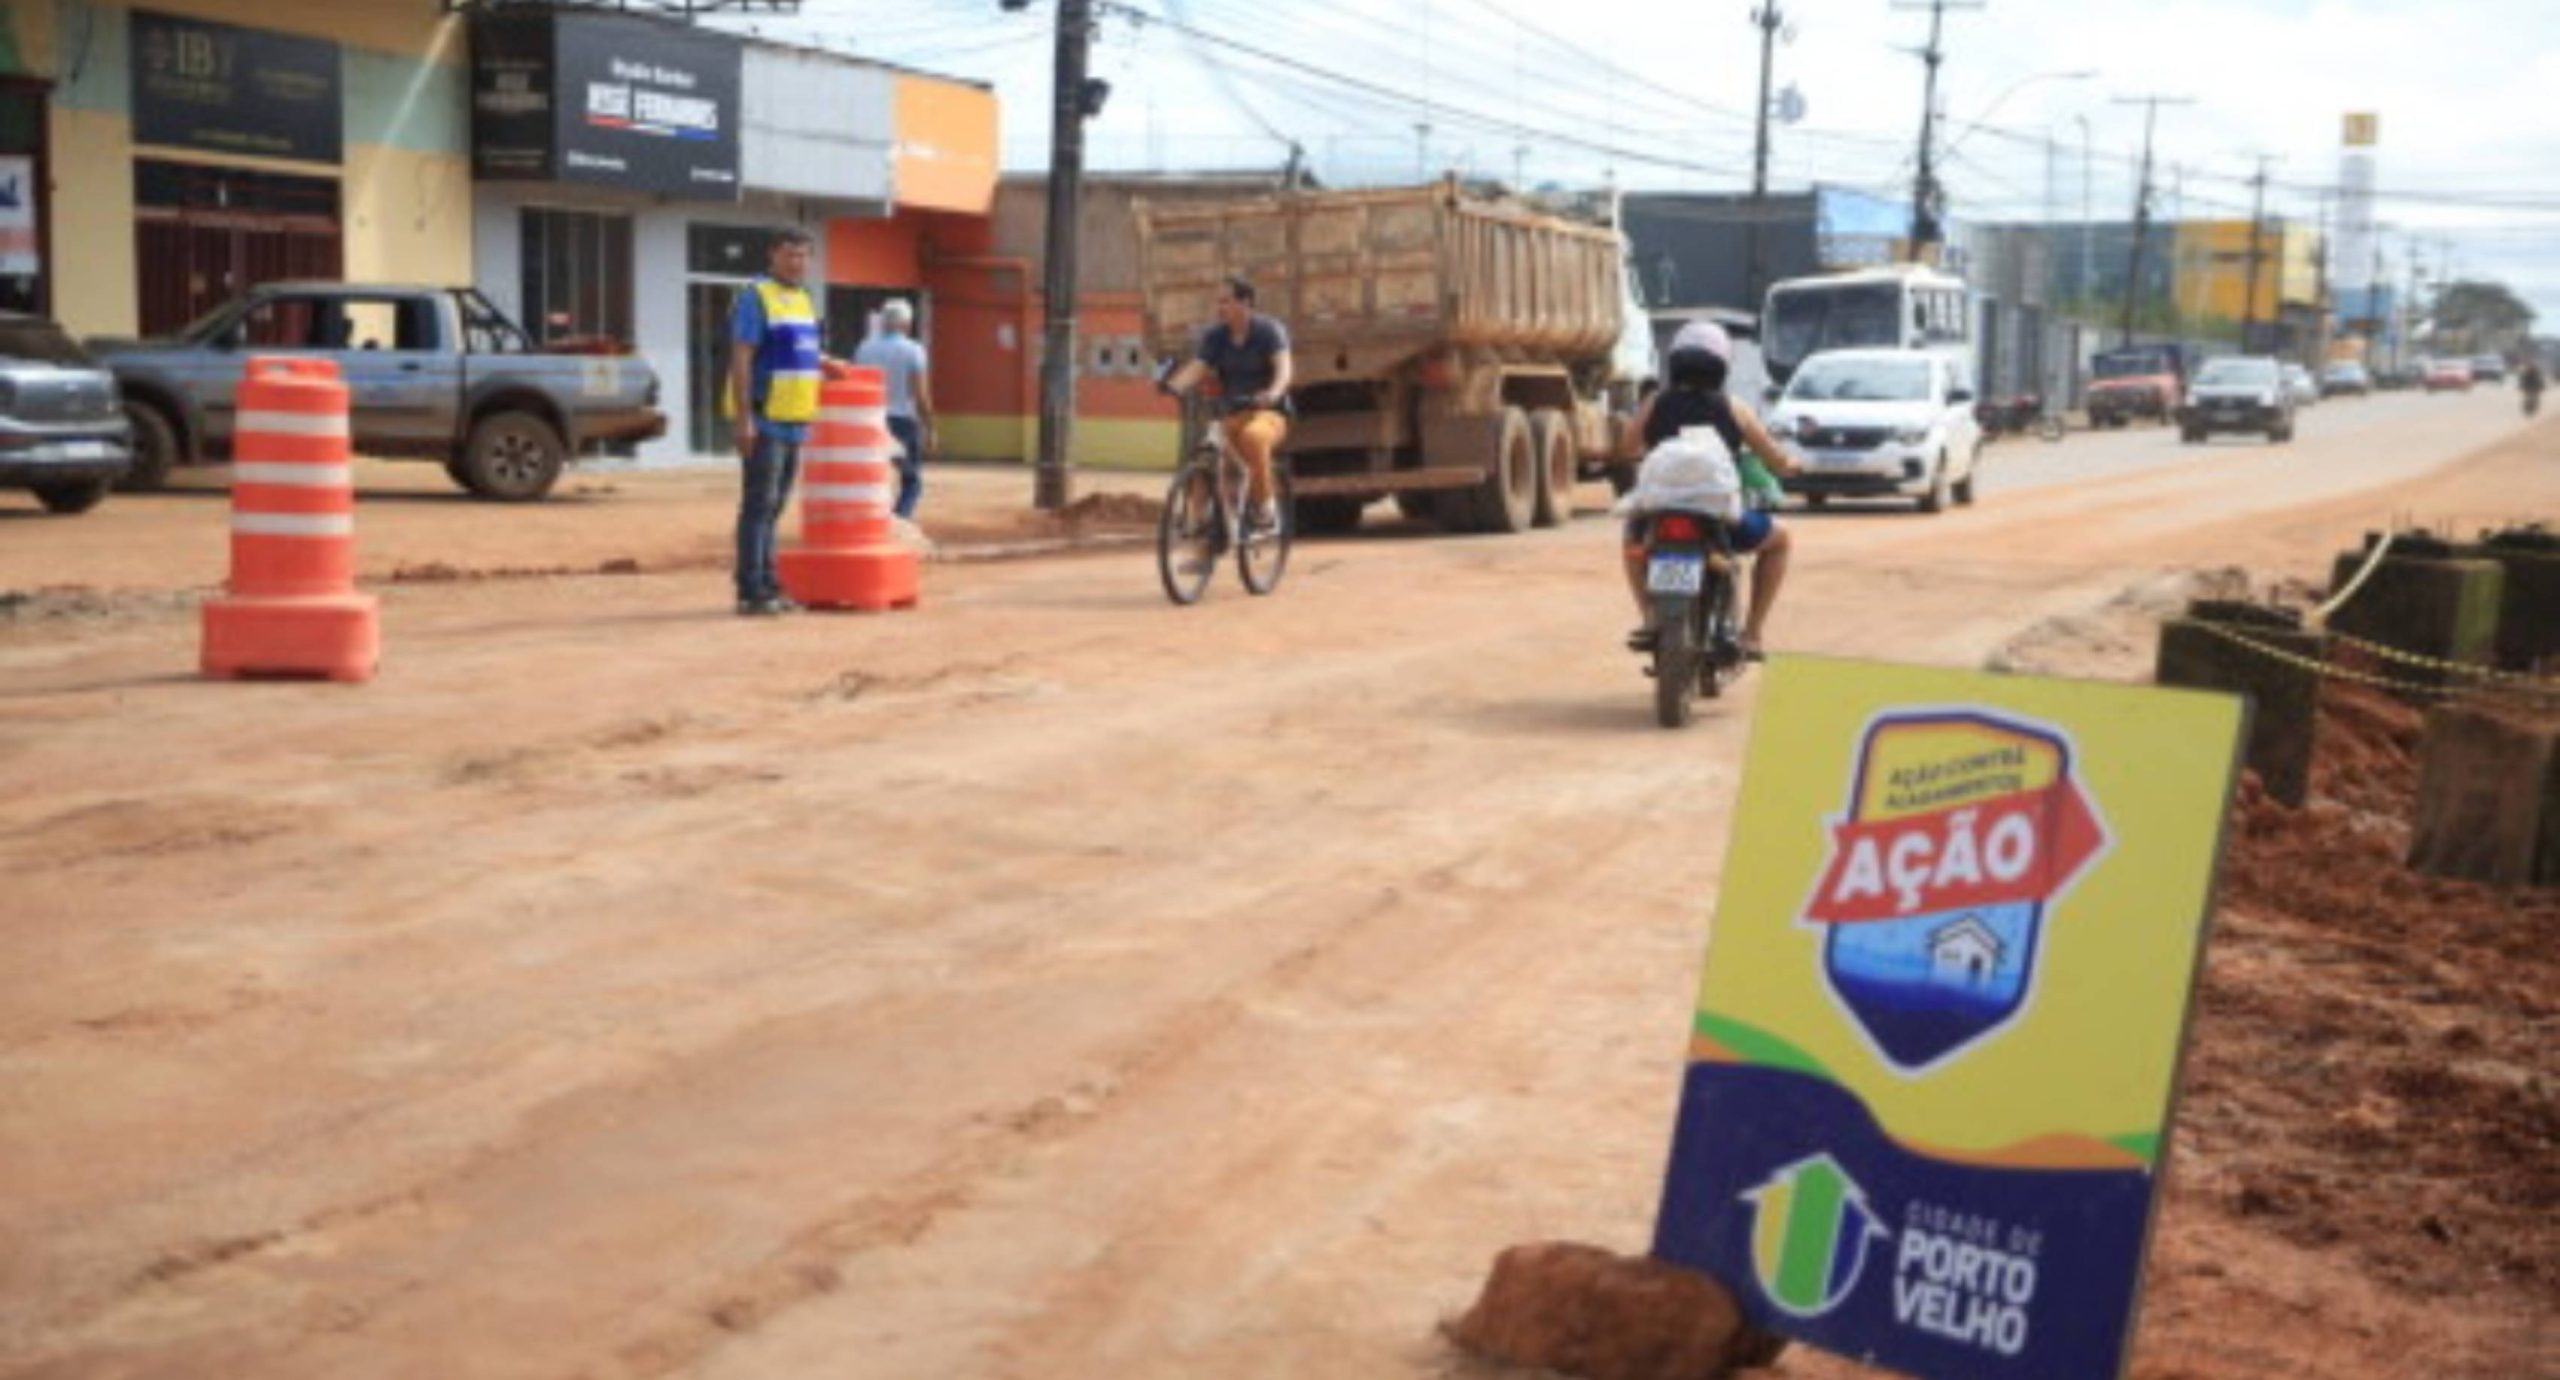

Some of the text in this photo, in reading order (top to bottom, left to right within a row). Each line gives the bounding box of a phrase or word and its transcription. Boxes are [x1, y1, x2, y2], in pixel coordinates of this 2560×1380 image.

[1833, 805, 2036, 914] AÇÃO
[1899, 1226, 2037, 1305] PORTO
[1893, 1273, 2030, 1356] VELHO
